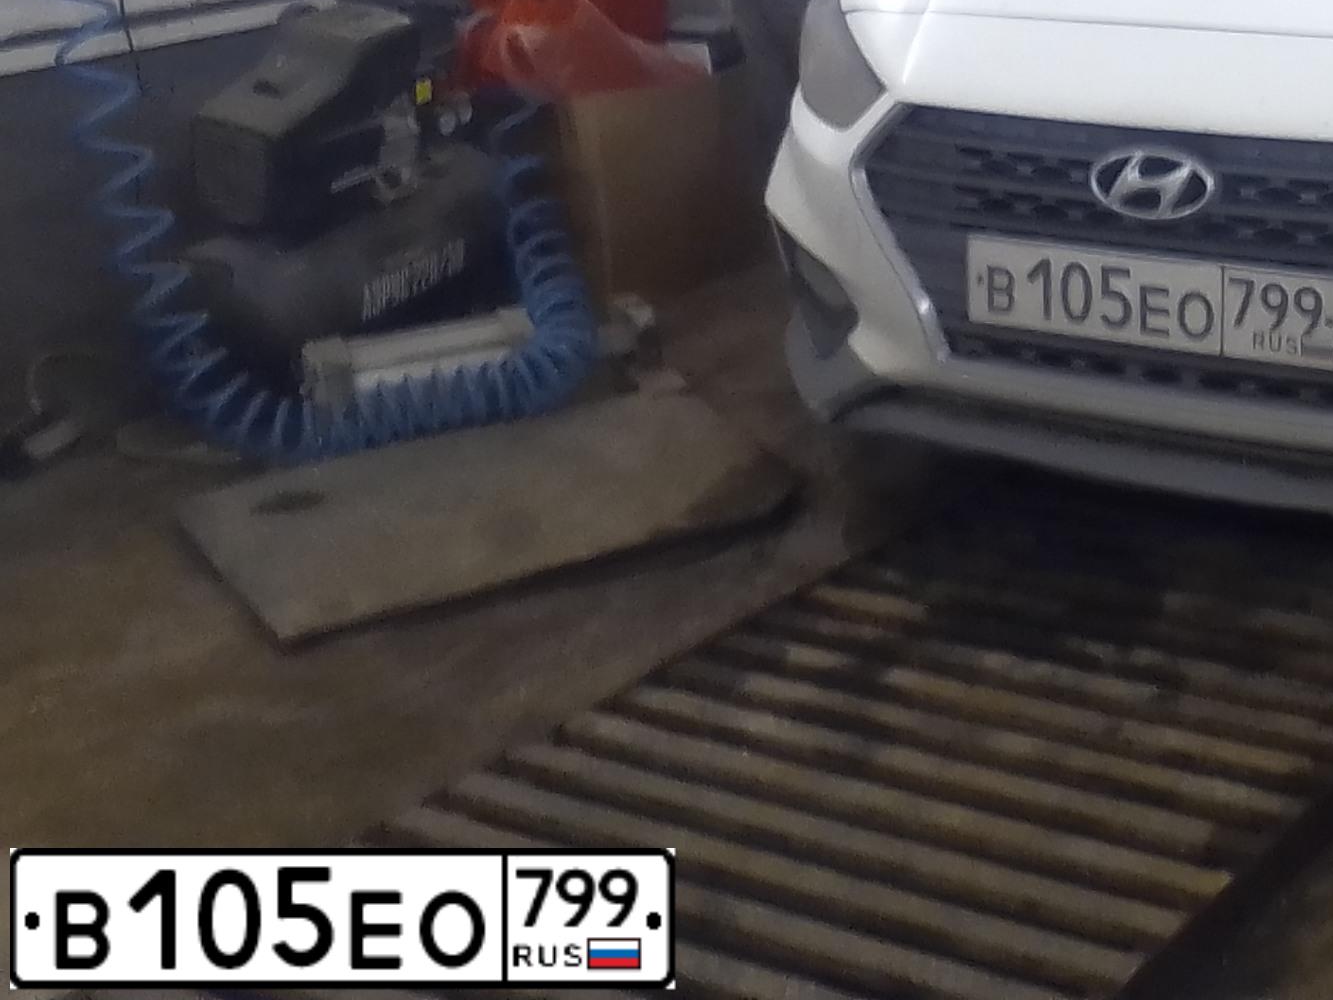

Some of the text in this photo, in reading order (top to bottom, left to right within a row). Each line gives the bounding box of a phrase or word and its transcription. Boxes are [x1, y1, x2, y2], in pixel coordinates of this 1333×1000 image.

[986, 258, 1324, 341] В105ЕО 799
[1252, 331, 1298, 355] RUS
